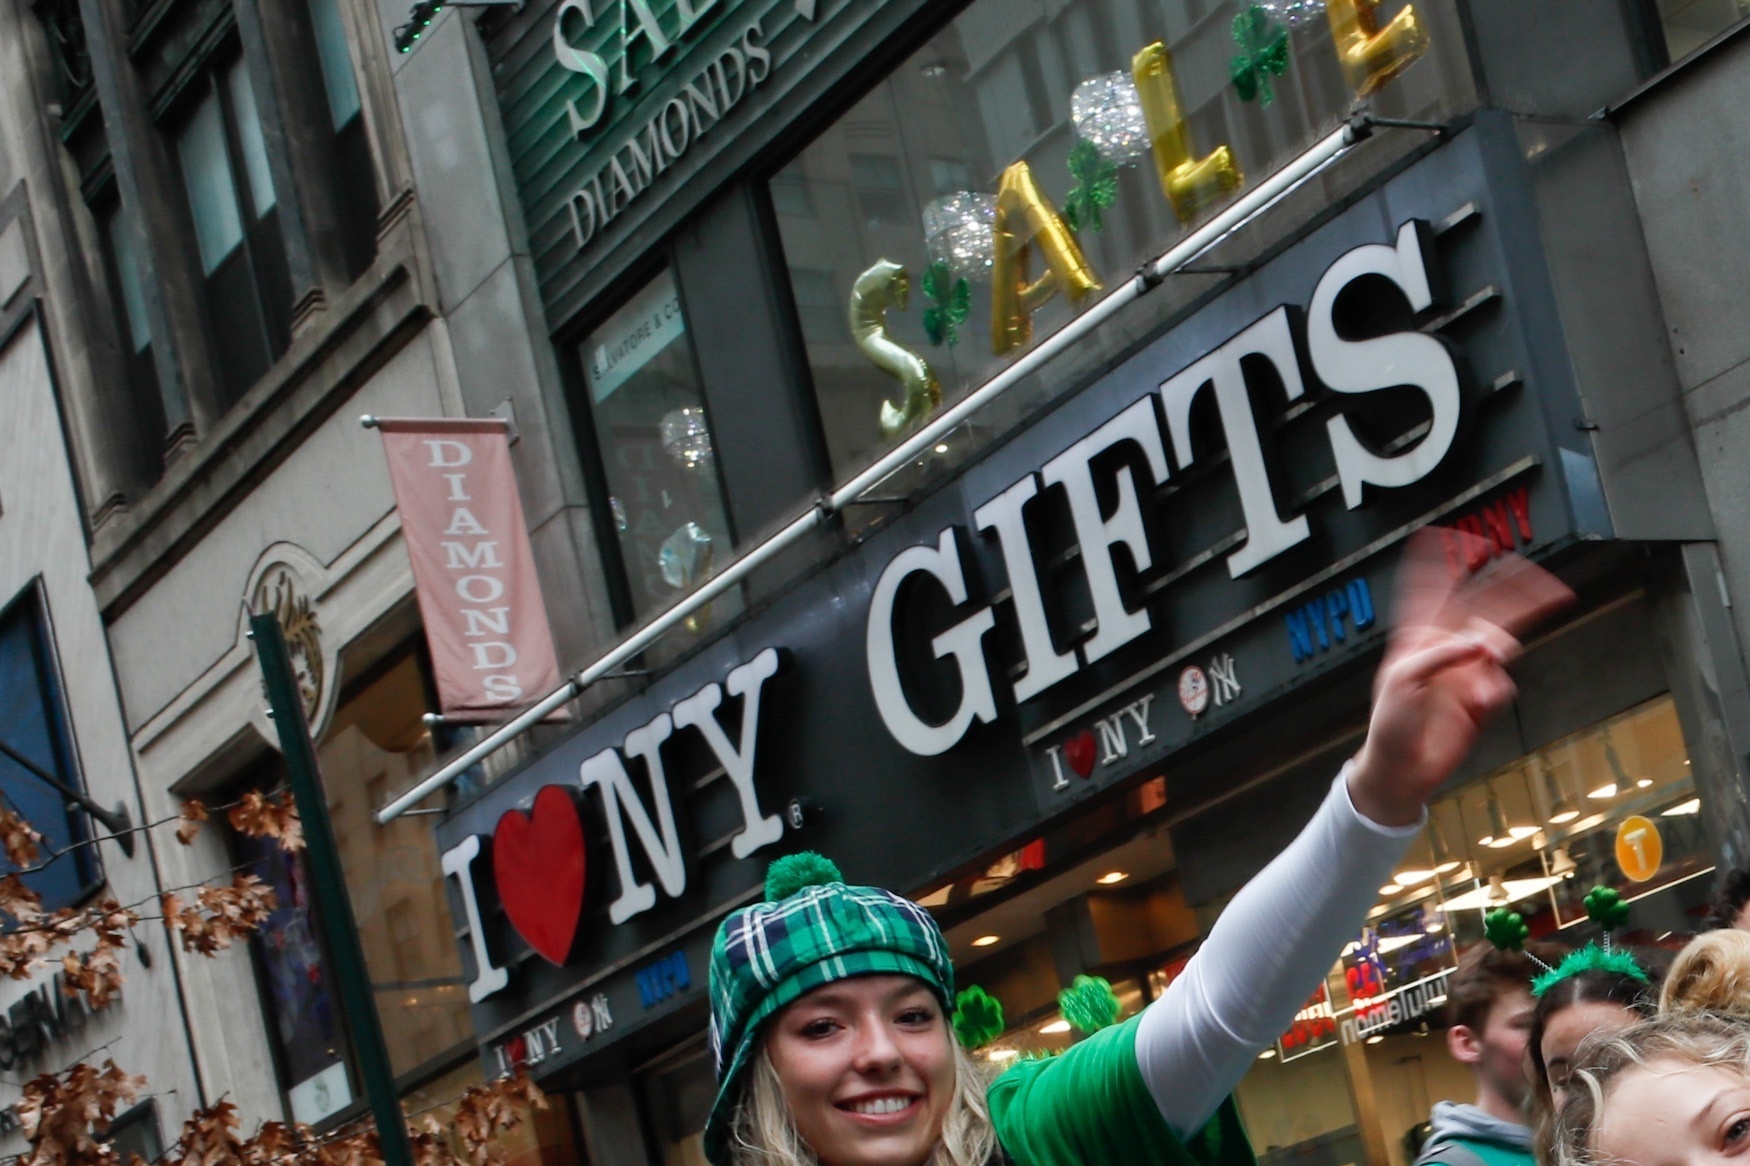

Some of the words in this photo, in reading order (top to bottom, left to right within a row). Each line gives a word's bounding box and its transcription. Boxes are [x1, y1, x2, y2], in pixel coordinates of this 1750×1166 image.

[566, 19, 771, 248] DIAMONDS
[594, 320, 653, 380] SLVATORE
[422, 439, 523, 702] DIAMONDS
[441, 833, 508, 1004] I
[580, 646, 784, 926] NY
[866, 218, 1461, 757] GIFTS
[1046, 744, 1070, 791] I
[1095, 693, 1156, 767] NY
[1285, 576, 1376, 663] NYPD
[494, 1044, 510, 1079] I
[523, 1015, 563, 1066] NY
